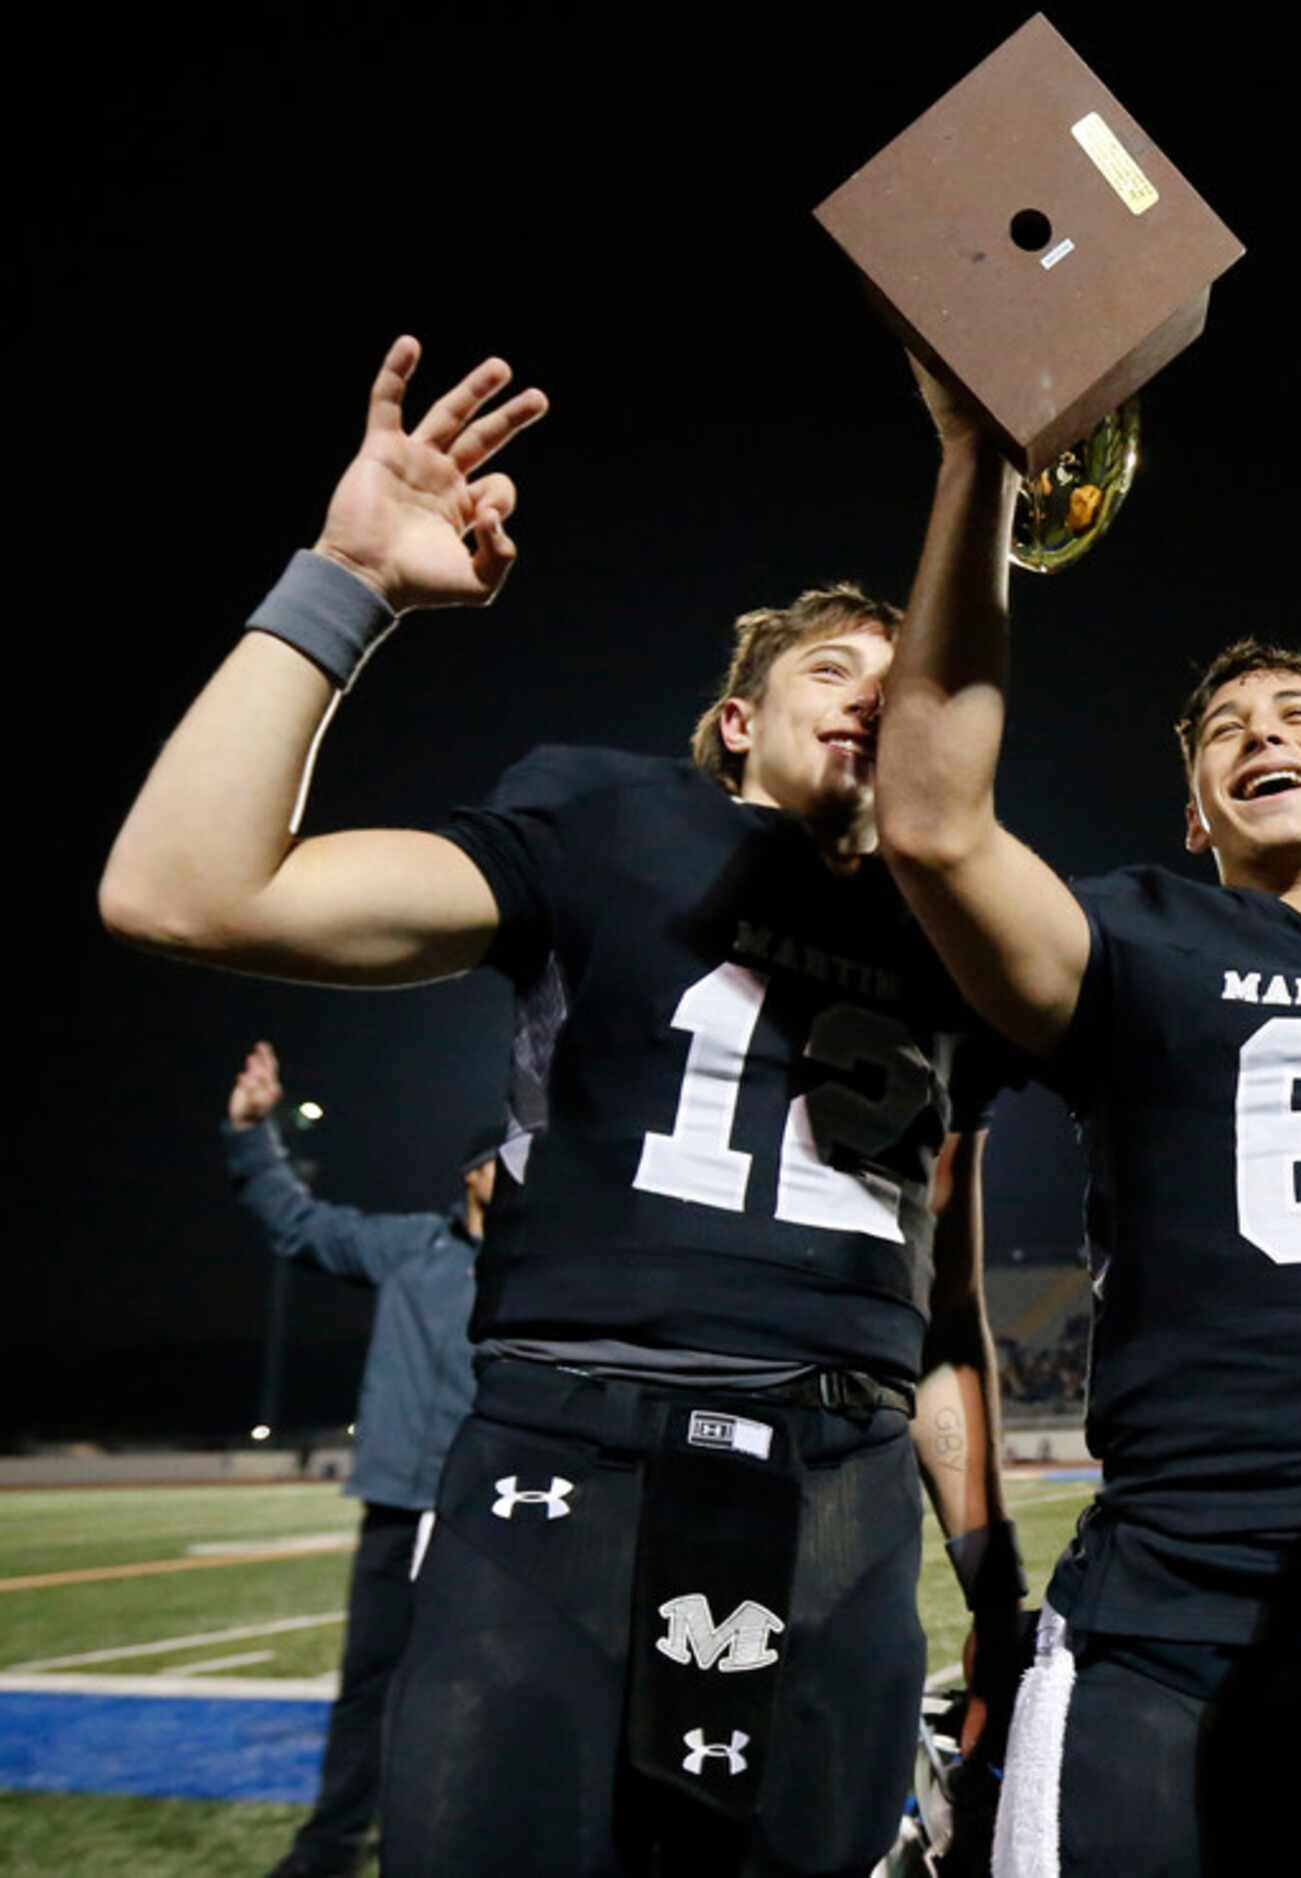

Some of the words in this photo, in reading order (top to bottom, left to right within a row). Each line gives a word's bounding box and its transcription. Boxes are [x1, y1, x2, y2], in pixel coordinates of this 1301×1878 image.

[732, 920, 902, 999] MARTIN
[631, 960, 934, 1245] 12
[655, 1592, 786, 1674] M
